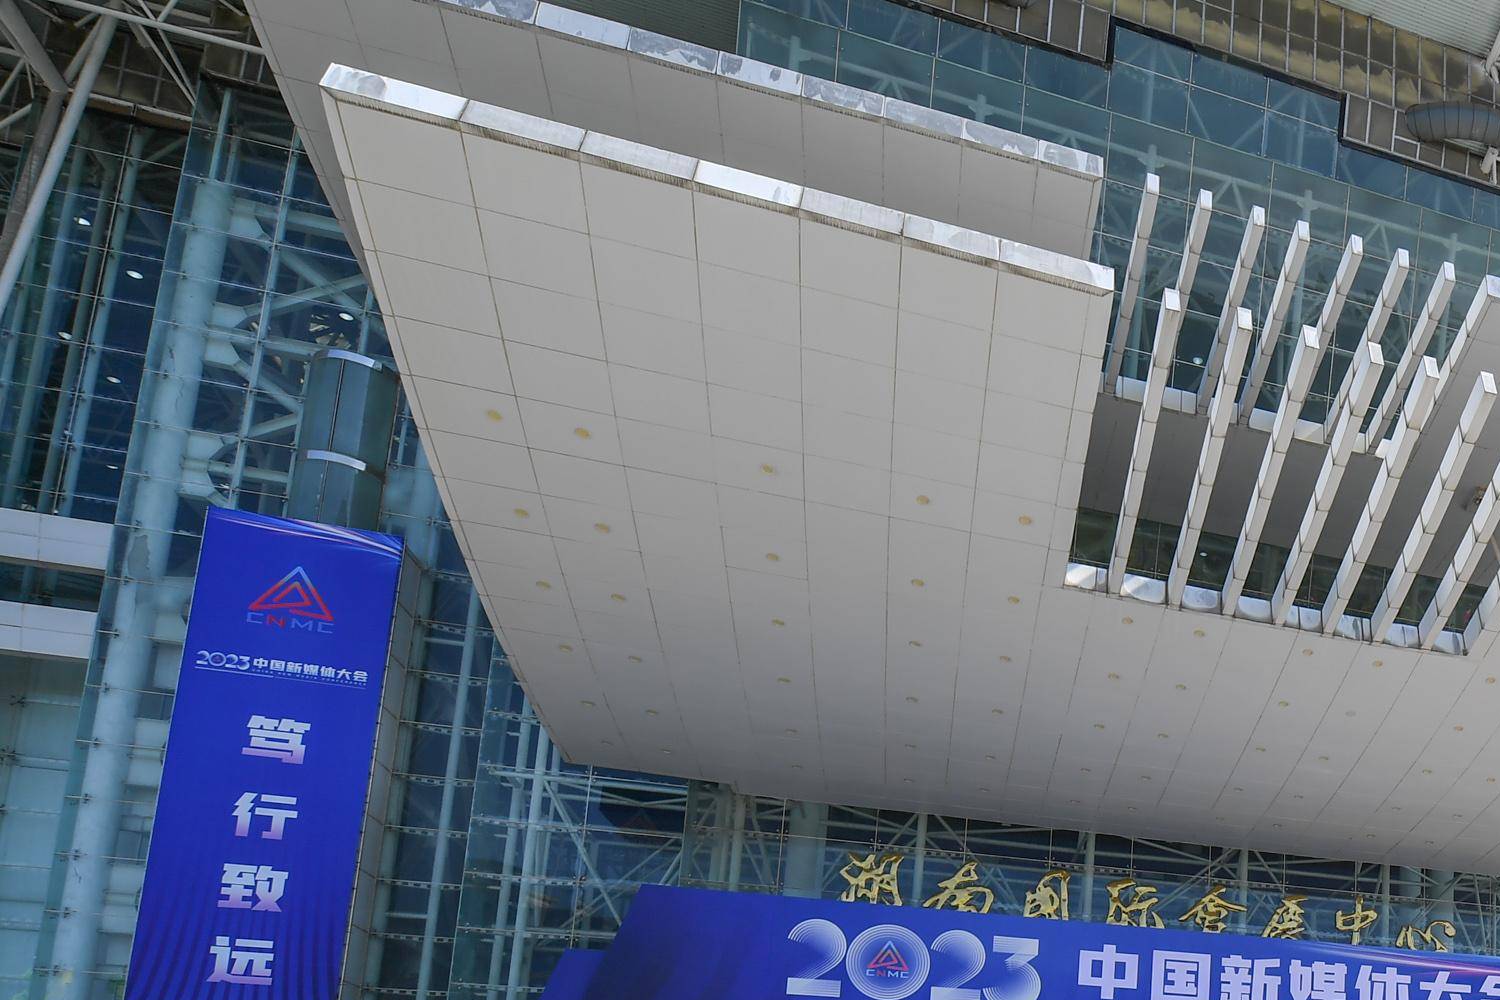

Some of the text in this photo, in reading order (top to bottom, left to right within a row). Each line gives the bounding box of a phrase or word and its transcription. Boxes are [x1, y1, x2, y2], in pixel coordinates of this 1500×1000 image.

[246, 611, 334, 634] CNMC
[195, 650, 251, 671] 2023
[253, 657, 369, 683] 中国新媒体大会
[206, 714, 311, 987] 笃行致远
[865, 968, 909, 980] CNMC
